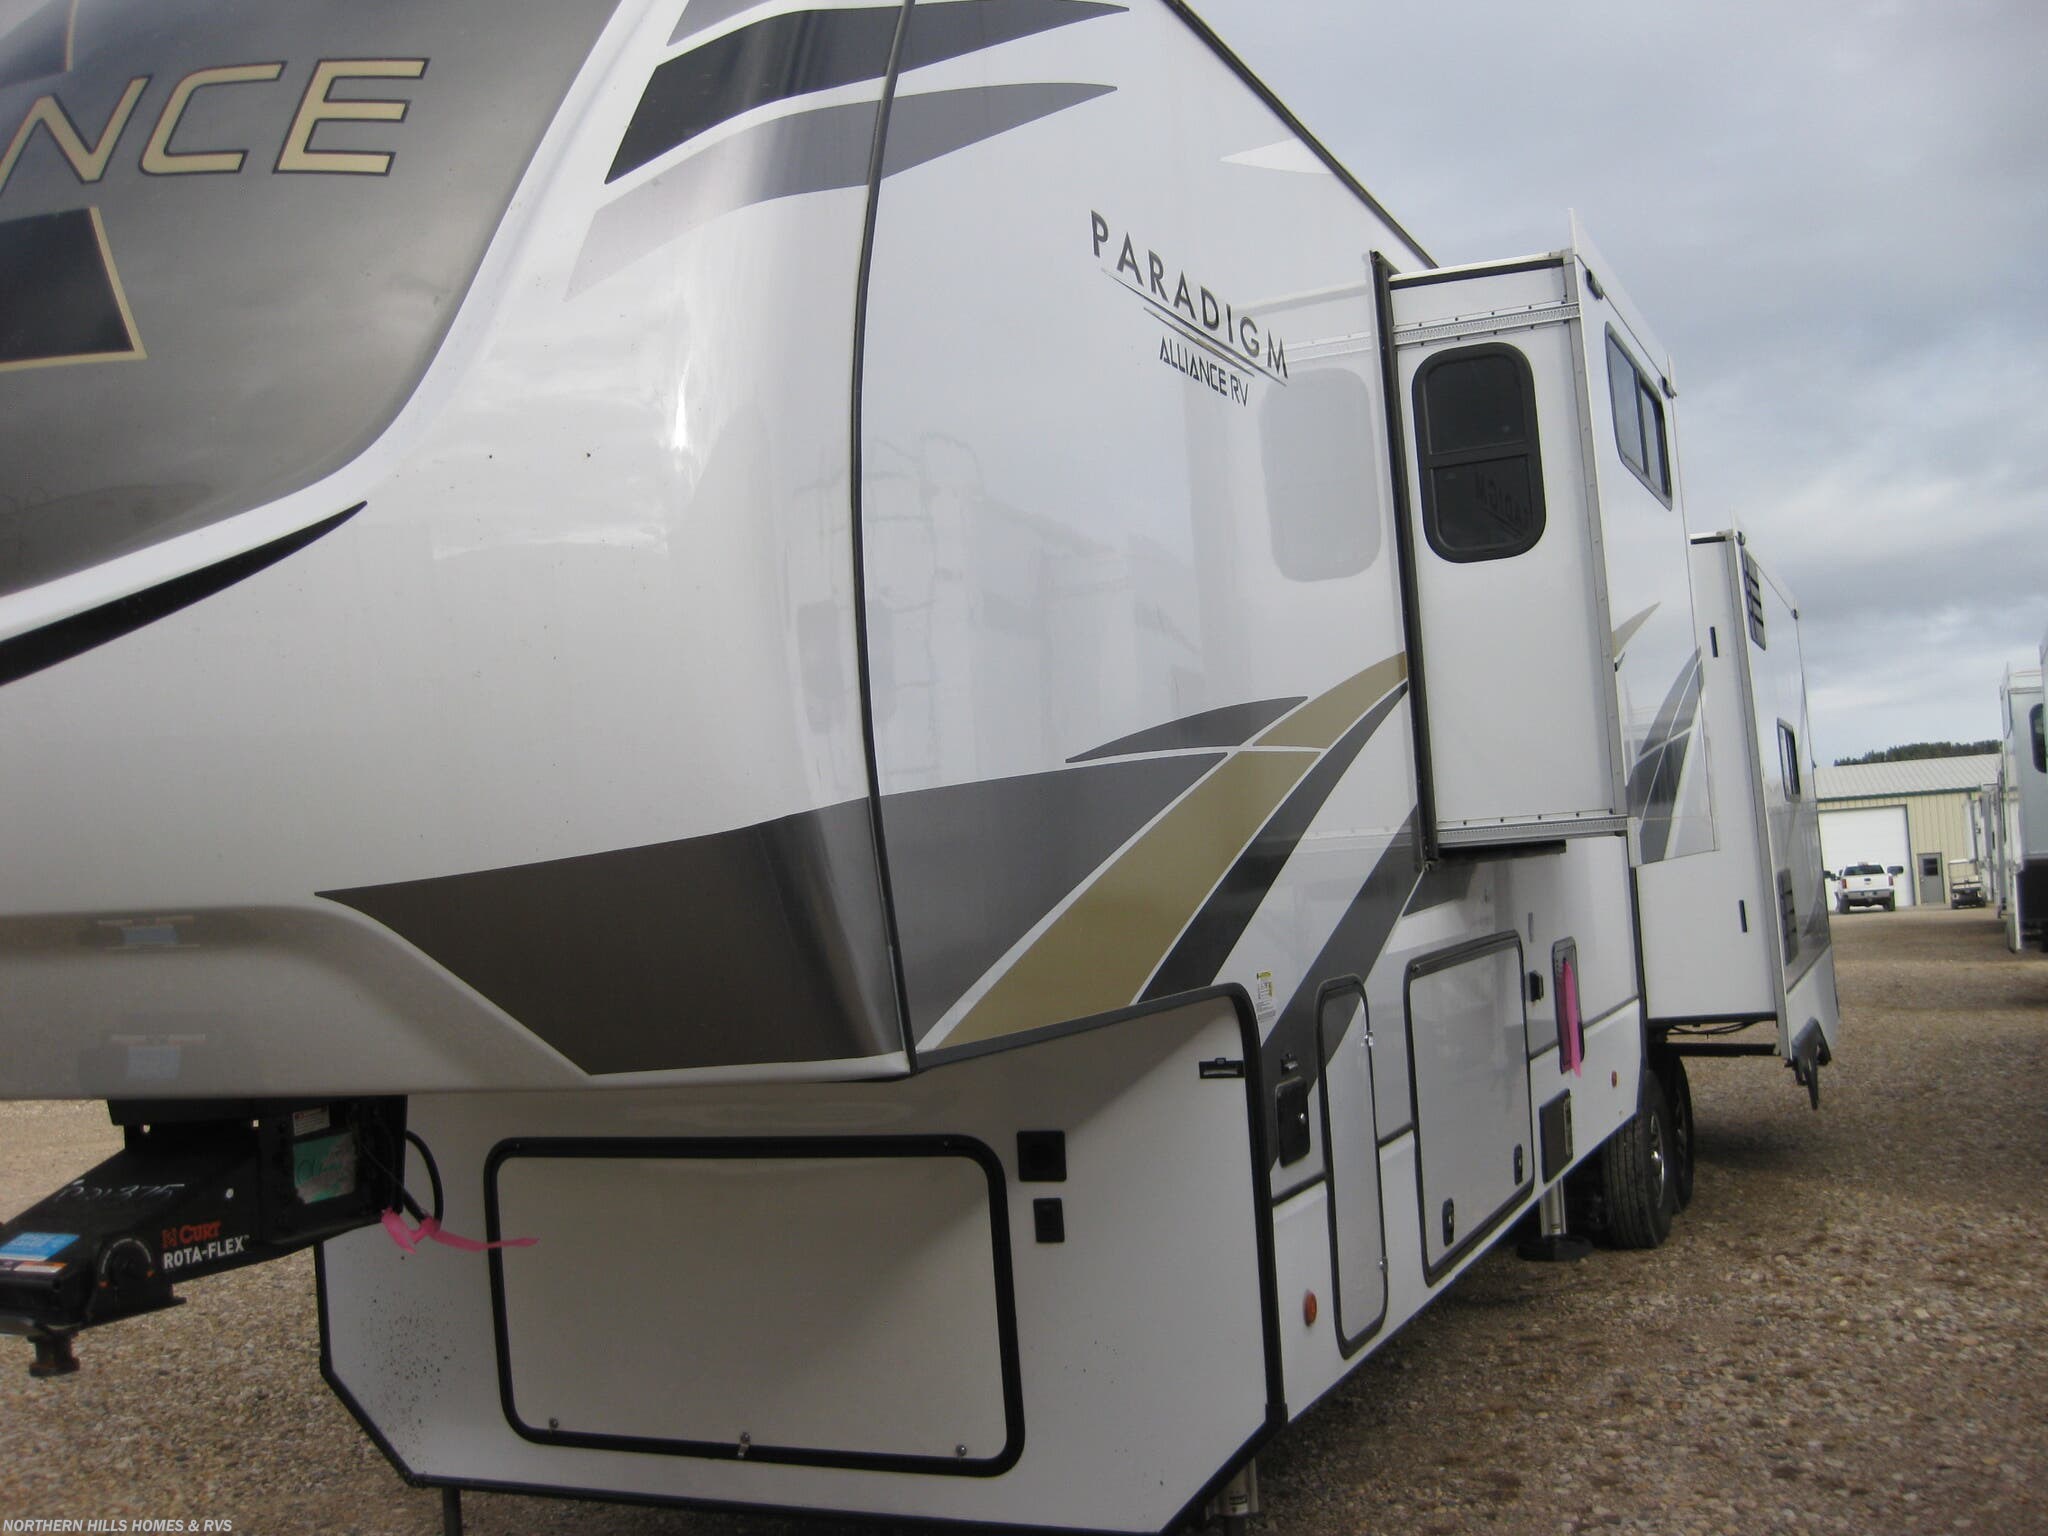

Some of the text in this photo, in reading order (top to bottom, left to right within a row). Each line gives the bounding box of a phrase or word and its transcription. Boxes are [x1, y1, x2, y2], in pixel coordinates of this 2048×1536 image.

[1090, 209, 1288, 379] PARADIGM
[1159, 335, 1249, 407] ALLIANCE RV
[178, 1221, 222, 1245] CURT
